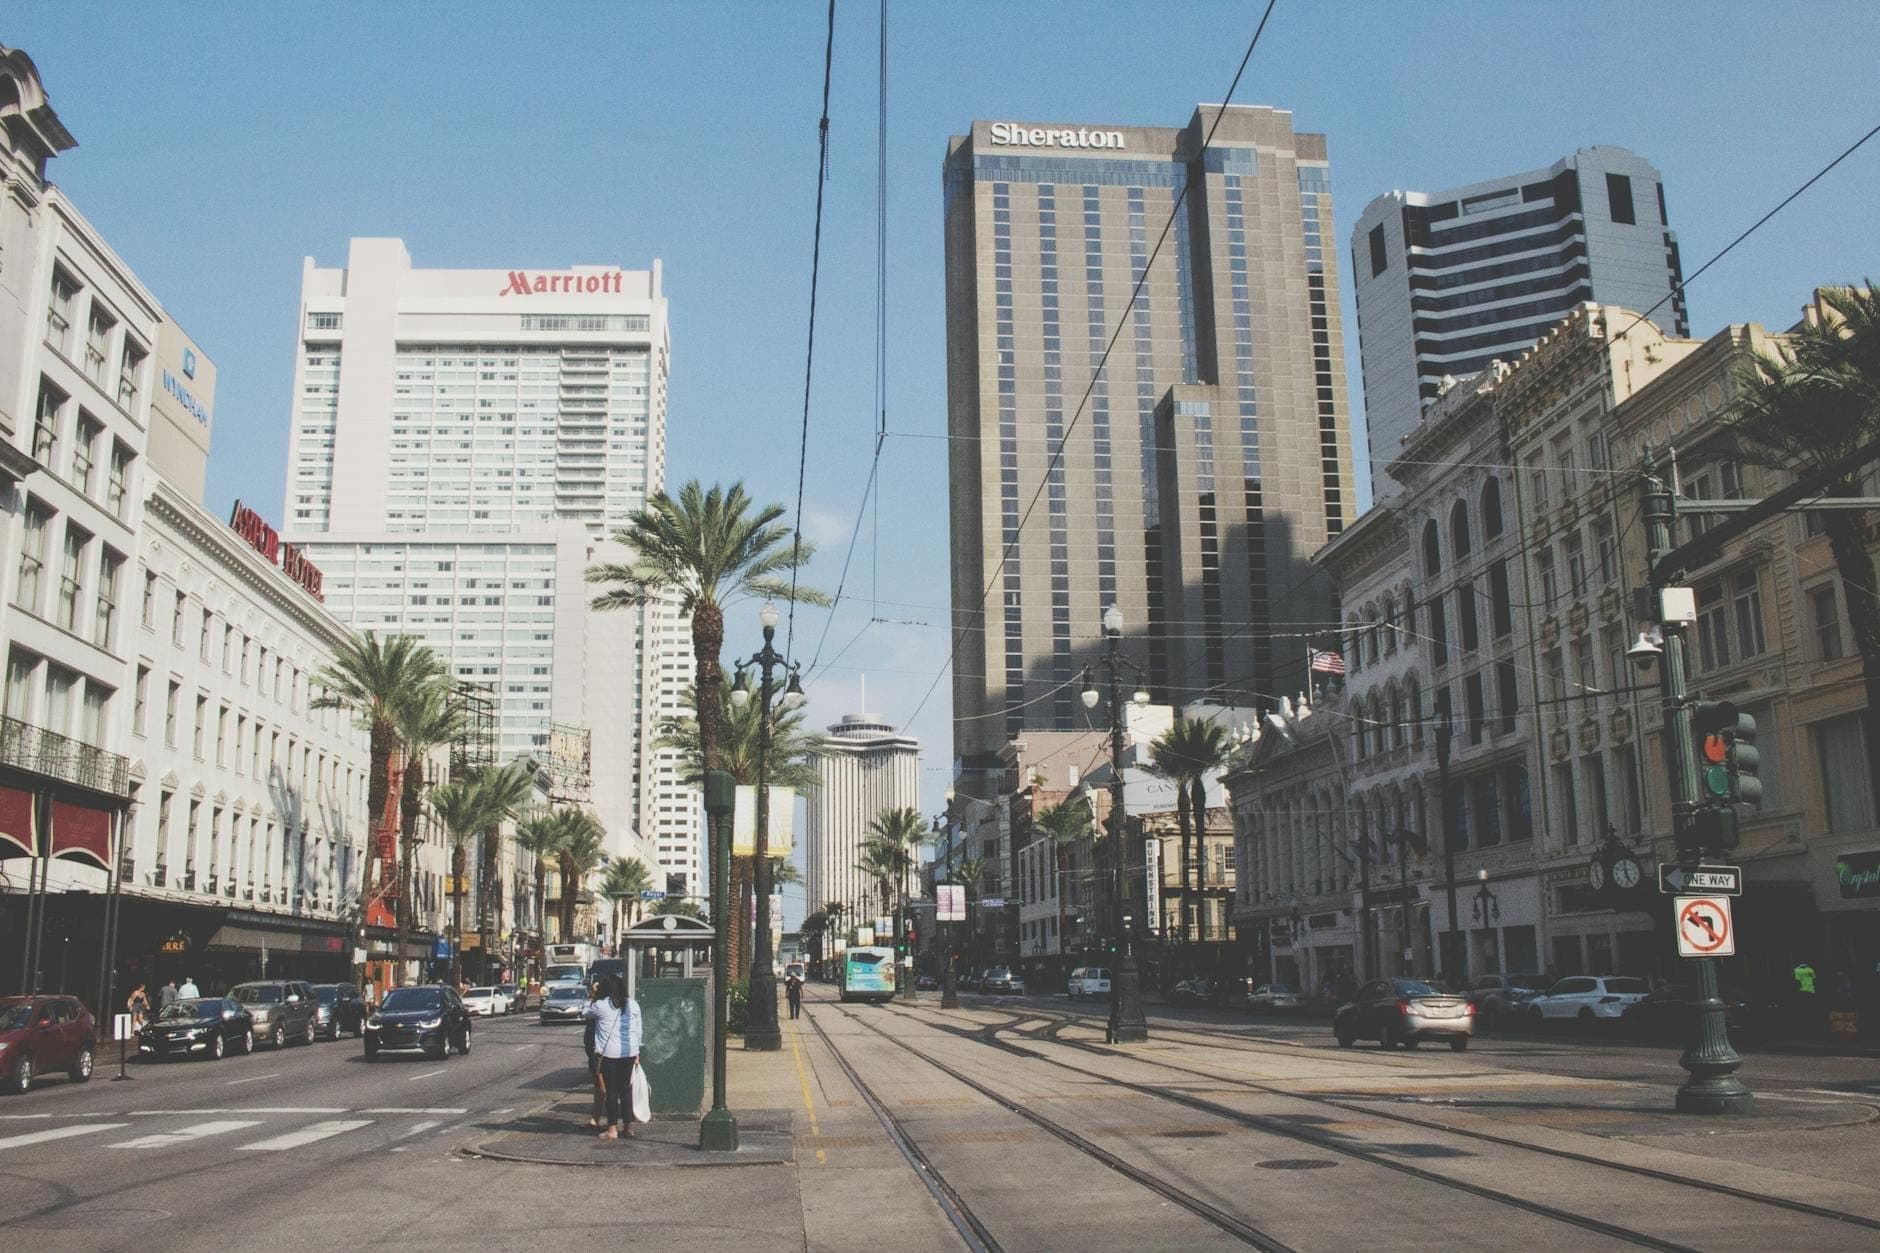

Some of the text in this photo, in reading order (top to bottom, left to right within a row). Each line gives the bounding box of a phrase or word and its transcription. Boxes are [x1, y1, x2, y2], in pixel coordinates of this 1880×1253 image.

[991, 122, 1125, 149] Sheraton
[499, 271, 622, 296] Marriott
[230, 499, 325, 604] ASTOR HOTEL
[1684, 874, 1731, 887] ONE WAY
